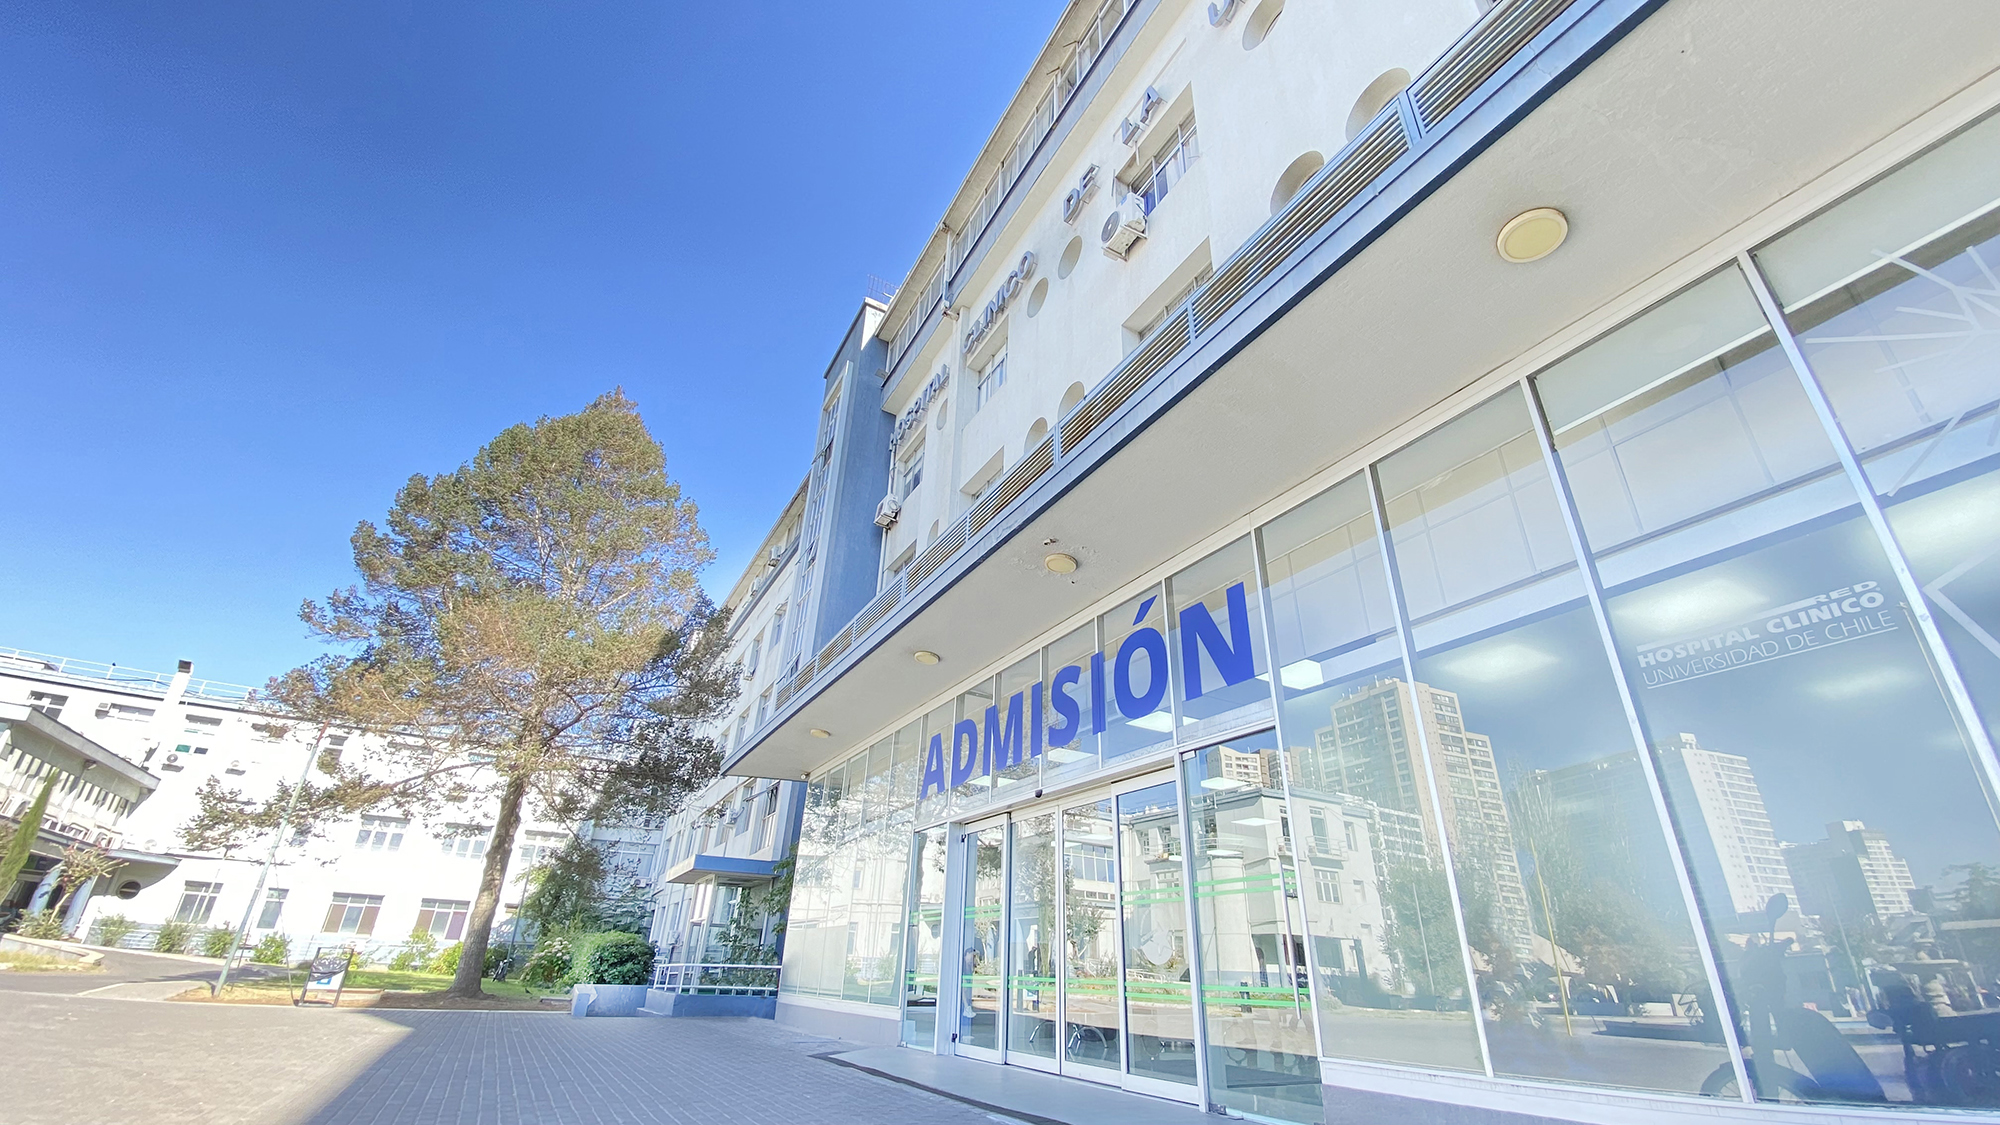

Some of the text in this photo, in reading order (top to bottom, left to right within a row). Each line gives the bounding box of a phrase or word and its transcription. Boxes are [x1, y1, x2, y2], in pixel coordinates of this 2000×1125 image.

[962, 250, 1035, 354] CLINICO
[1064, 164, 1100, 224] DE
[1121, 85, 1161, 147] LA
[1636, 591, 1885, 669] HOSPITAL CLINICO
[1811, 580, 1878, 604] RED
[1642, 609, 1896, 686] UNIVERSIDAD DE CHILE
[920, 581, 1255, 800] ADMISIÓN
